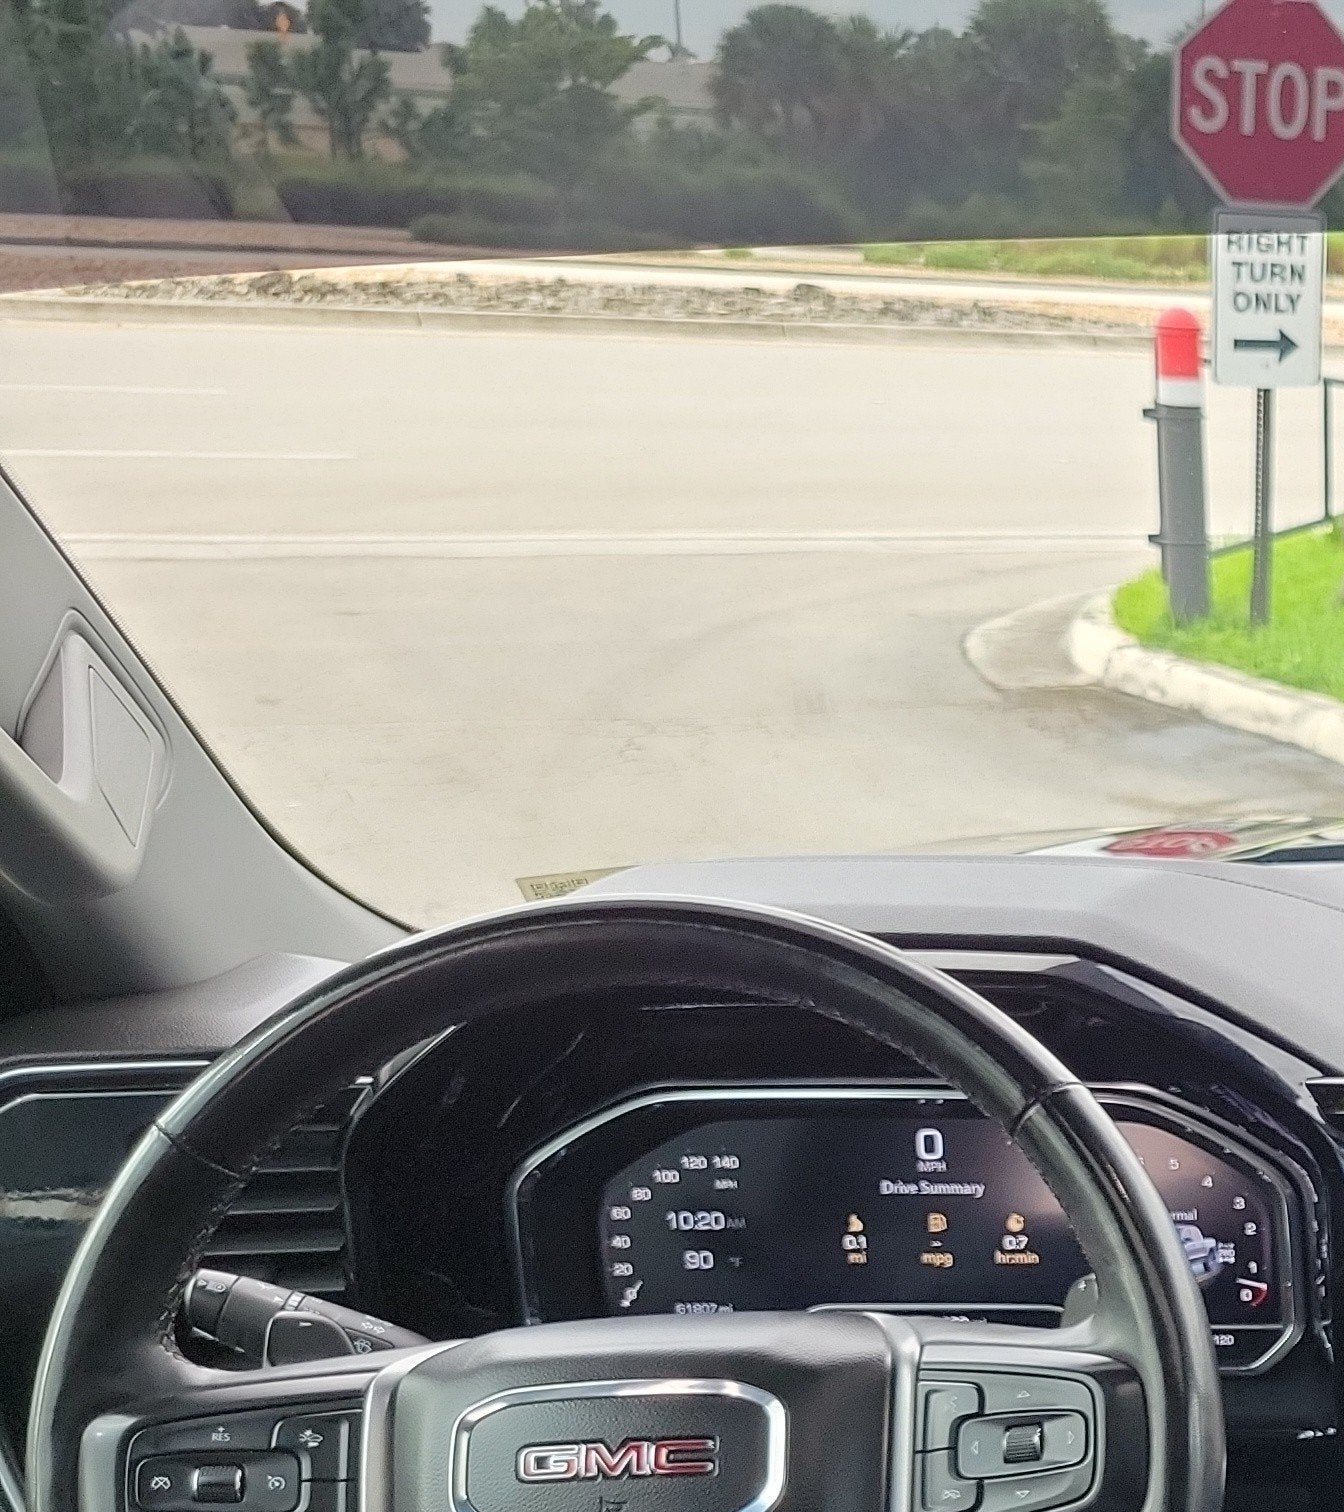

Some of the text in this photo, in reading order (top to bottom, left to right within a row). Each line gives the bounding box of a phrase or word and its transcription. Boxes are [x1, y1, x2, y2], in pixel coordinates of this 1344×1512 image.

[1226, 231, 1309, 254] RIGHT
[1232, 262, 1306, 284] TURN
[1232, 291, 1301, 314] ONLY
[915, 1128, 944, 1160] 0
[680, 1155, 740, 1169] 120 140
[916, 1160, 947, 1173] MPH
[1169, 1159, 1180, 1170] 5
[652, 1169, 680, 1183] 100
[1201, 1176, 1213, 1188] 4
[631, 1187, 652, 1201] 80
[879, 1180, 985, 1199] Drive Summary
[610, 1206, 632, 1220] 60
[1171, 1208, 1198, 1221] rmal
[1244, 1222, 1257, 1236] 2
[610, 1235, 632, 1249] 40
[683, 1250, 714, 1270] 90
[920, 1252, 954, 1268] mpg
[612, 1262, 634, 1277] 20
[211, 1432, 230, 1442] RES
[518, 1435, 719, 1483] GMC
